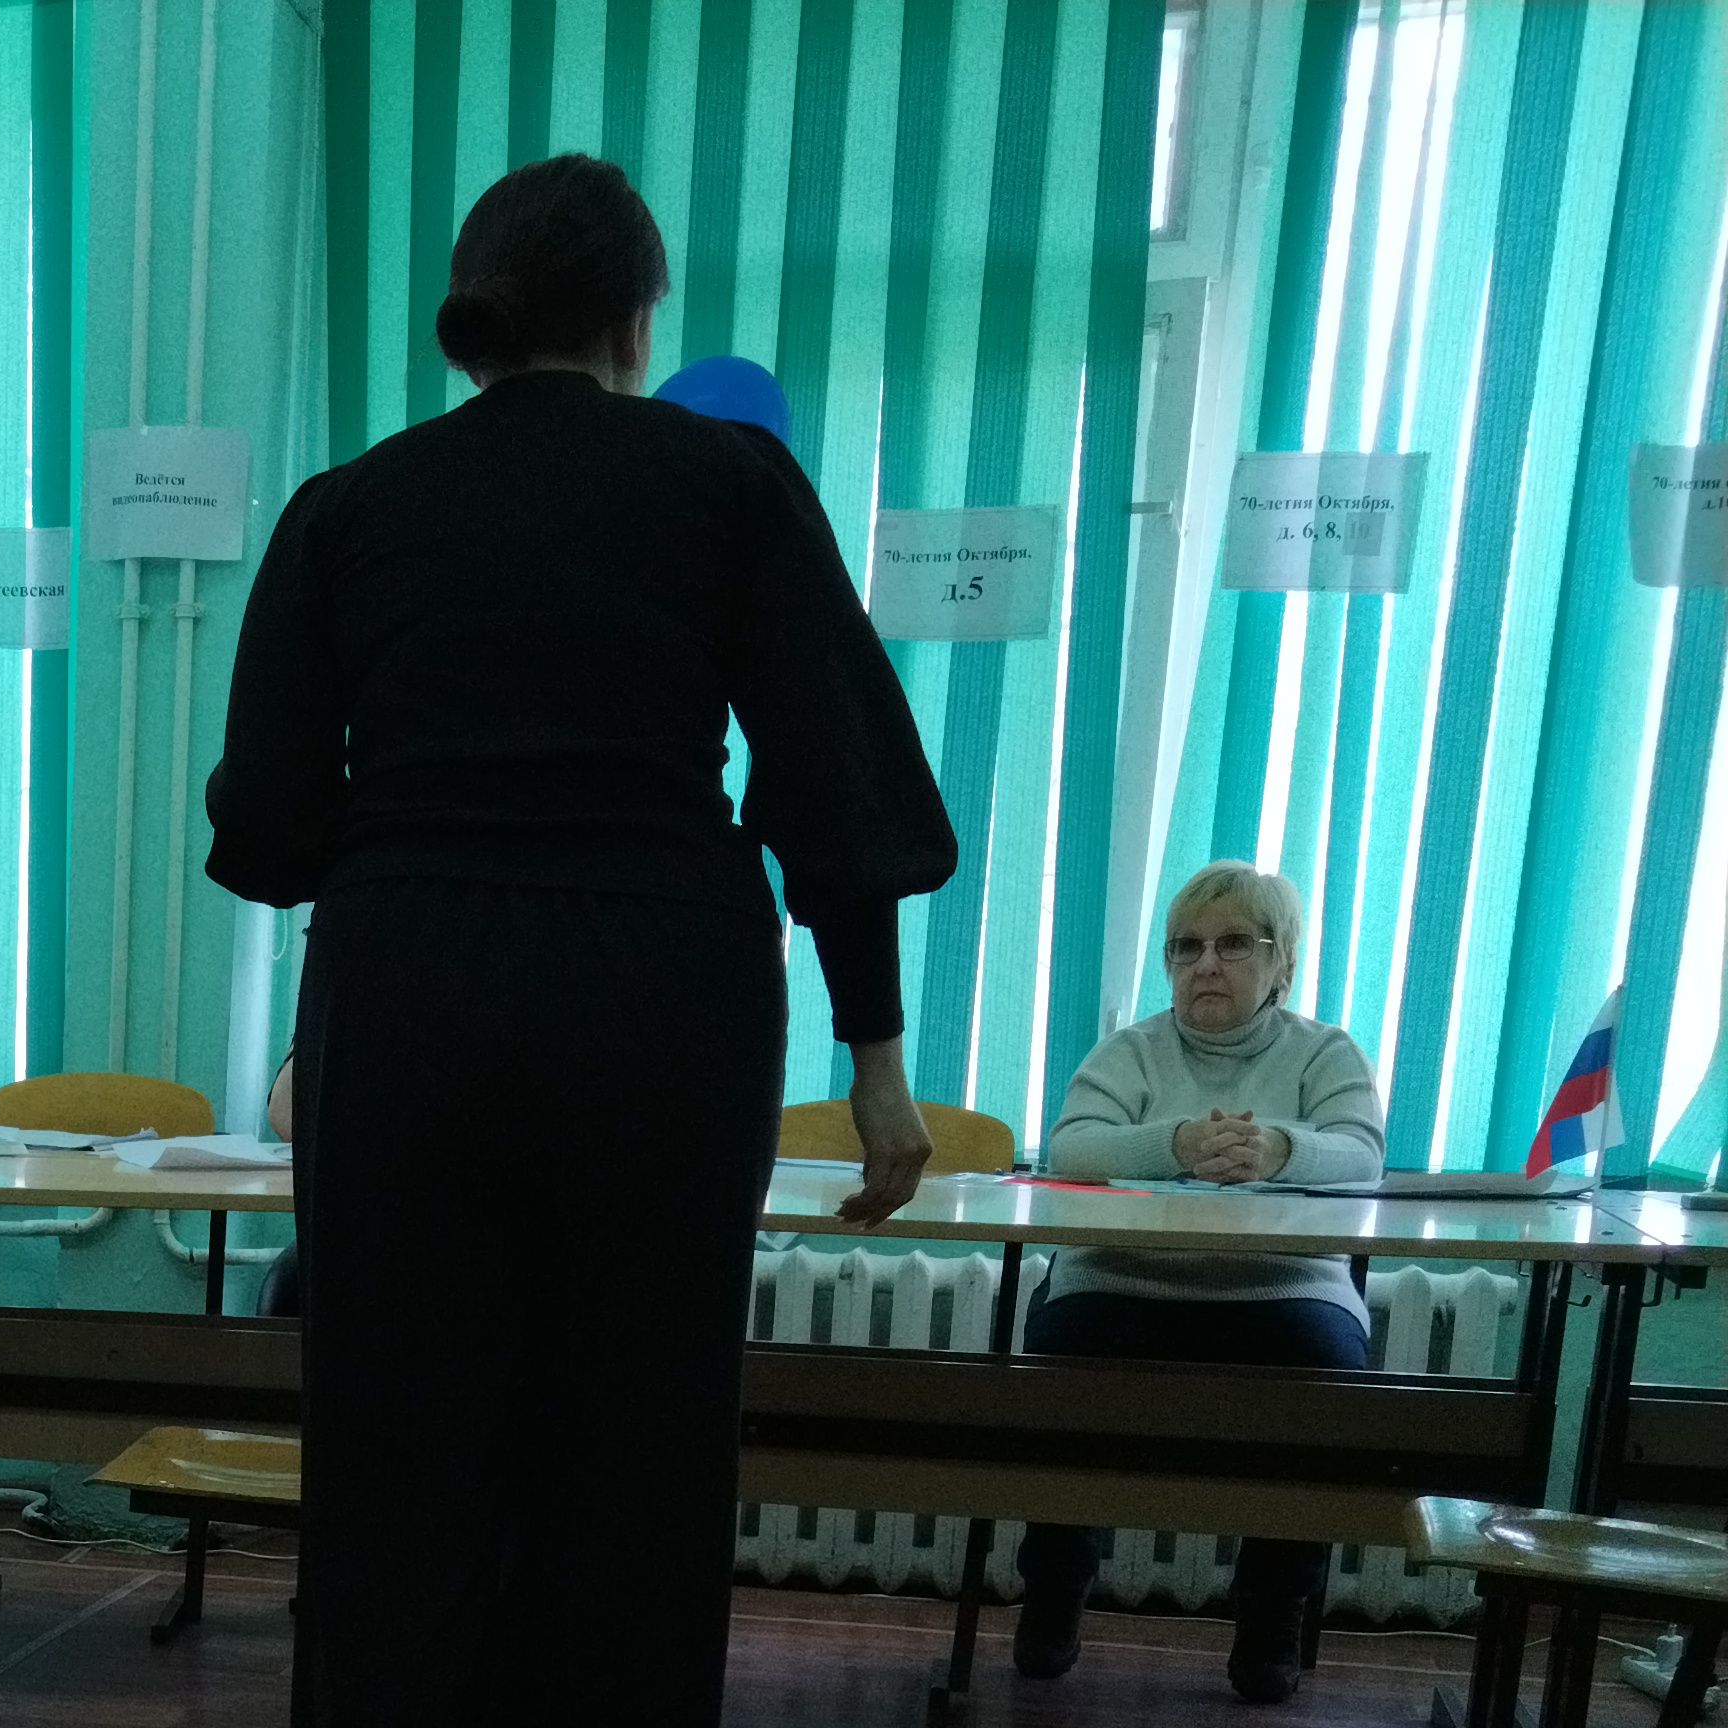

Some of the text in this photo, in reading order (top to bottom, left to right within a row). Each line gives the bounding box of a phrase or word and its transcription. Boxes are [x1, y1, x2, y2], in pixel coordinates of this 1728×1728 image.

[135, 472, 186, 486] Ведётся
[1652, 475, 1722, 490] 70-летия
[112, 490, 218, 508] видеонаблюдение
[1240, 494, 1395, 513] 70-летия Октября,
[1276, 526, 1295, 543] д.
[1302, 521, 1319, 542] 6,
[1325, 521, 1342, 542] 8,
[884, 546, 1032, 564] 70-летия Октября,
[941, 575, 984, 604] д.5
